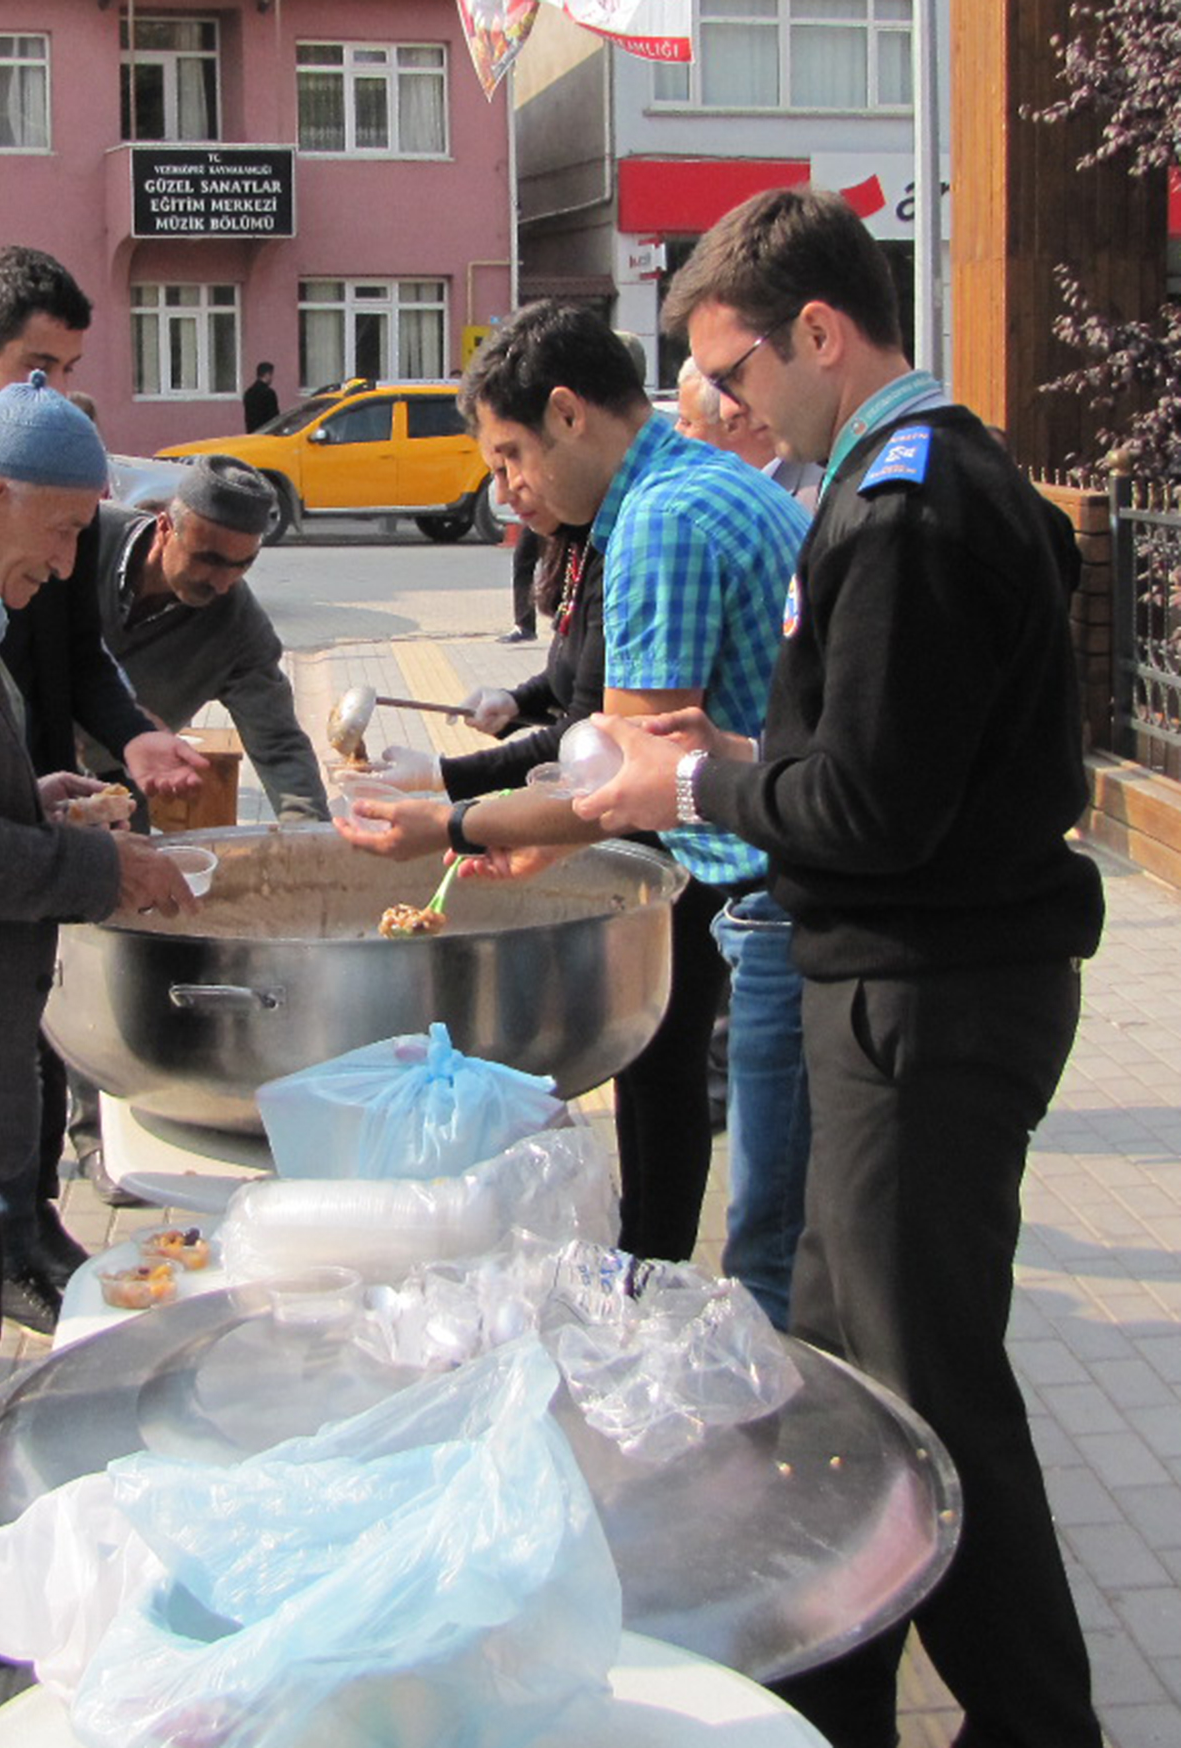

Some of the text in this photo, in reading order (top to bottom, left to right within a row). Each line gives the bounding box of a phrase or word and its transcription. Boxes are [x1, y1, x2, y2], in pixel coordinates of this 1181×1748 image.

[144, 178, 283, 194] GÜZEL SANATLAR
[150, 196, 277, 212] EĞİTİM MERKEZİ
[155, 215, 275, 231] MÜZİK BÖLÜMÜ
